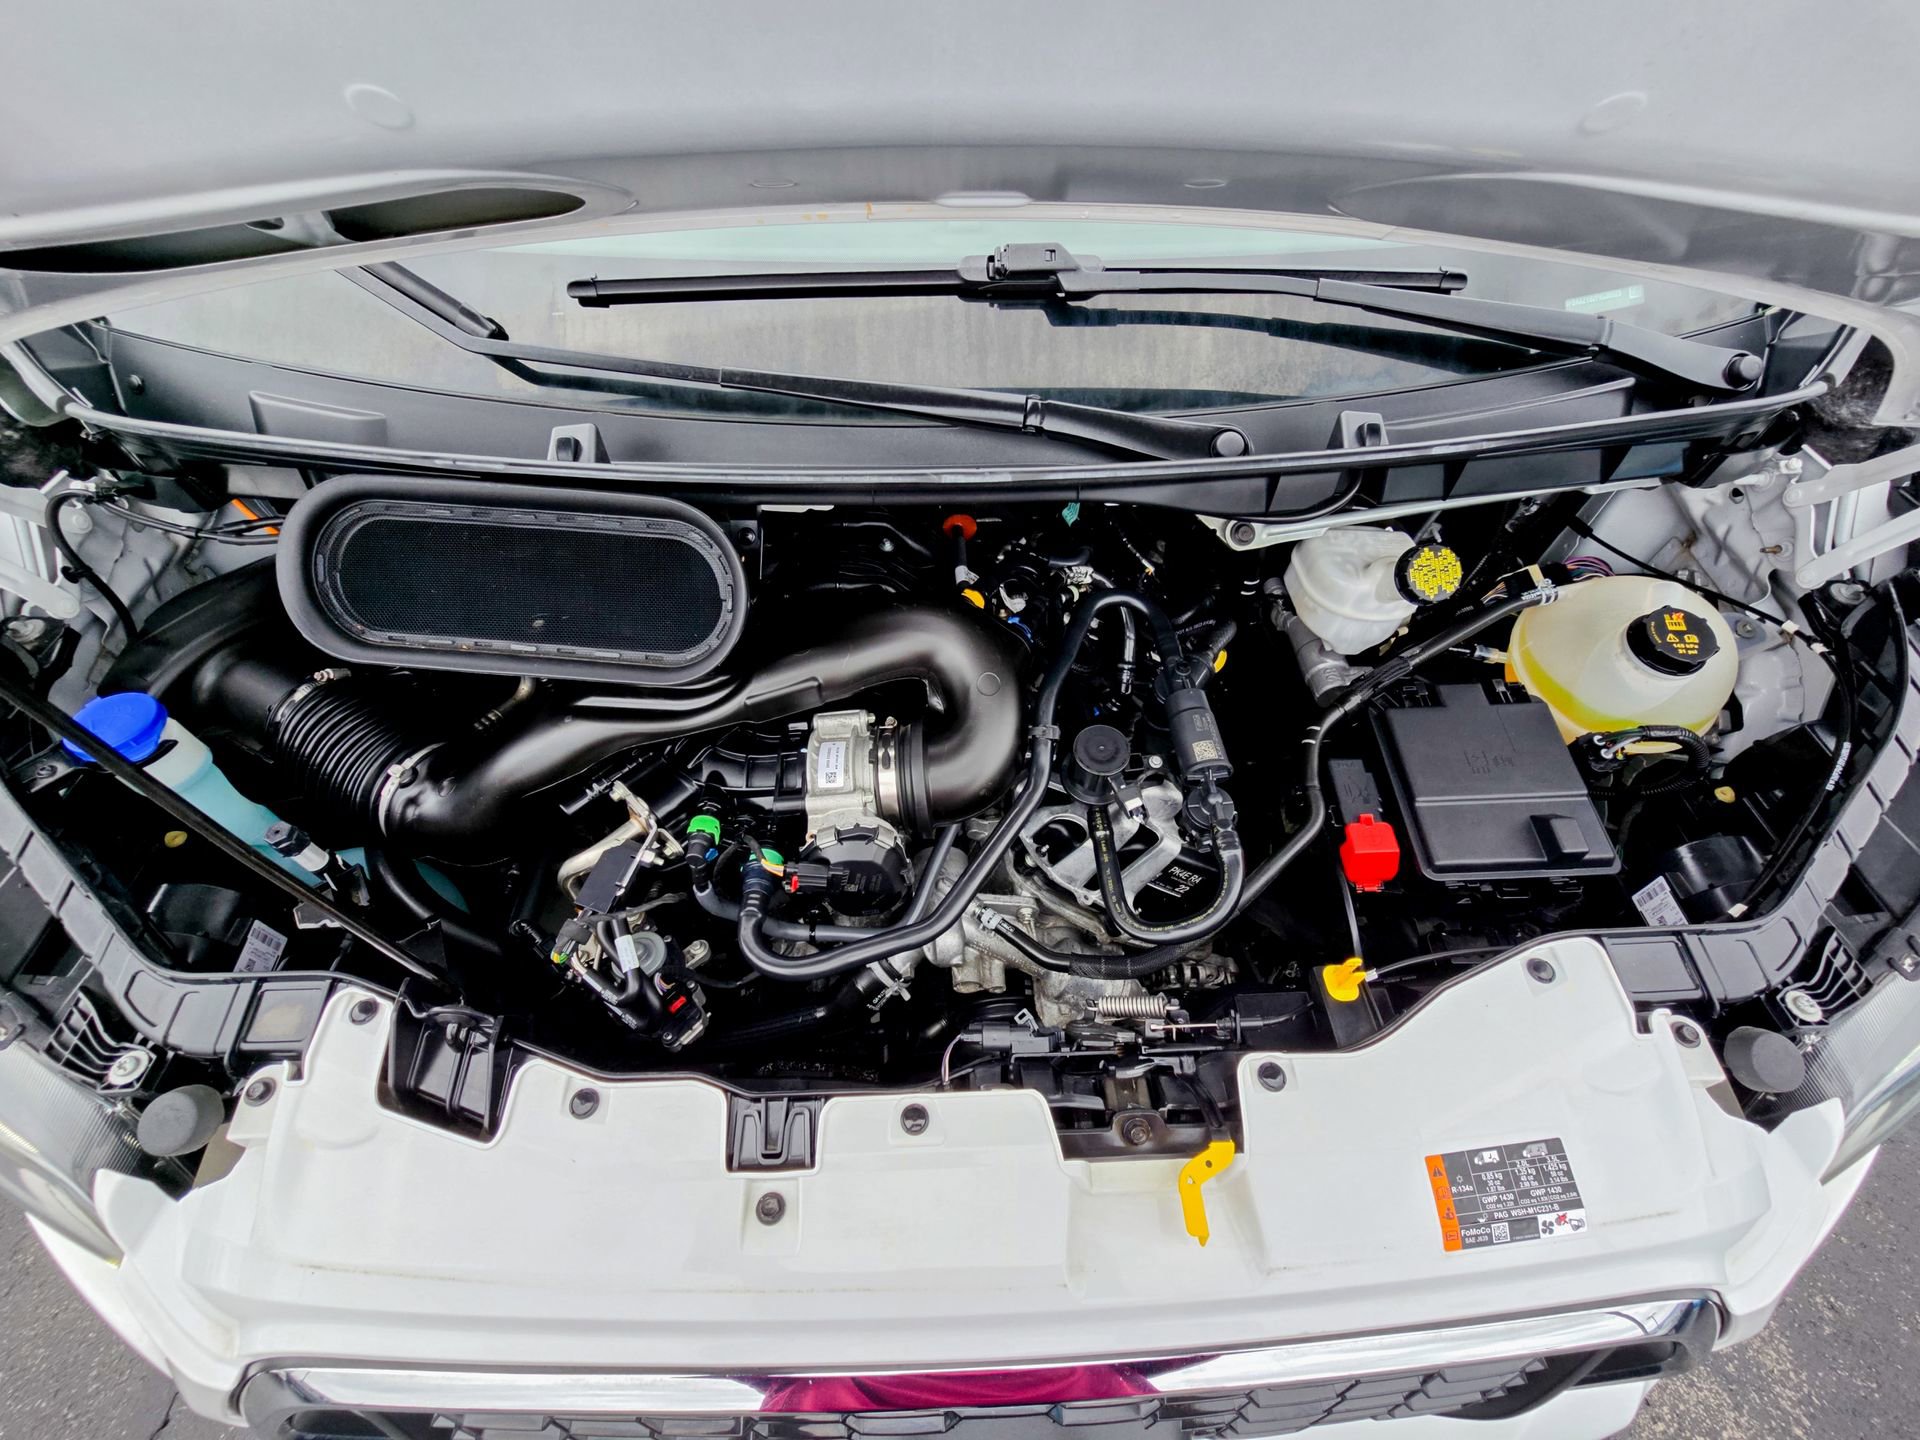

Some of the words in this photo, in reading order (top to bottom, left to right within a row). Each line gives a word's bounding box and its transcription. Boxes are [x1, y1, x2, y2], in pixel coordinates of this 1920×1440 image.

[1168, 866, 1191, 880] PK4E
[1188, 874, 1202, 884] RA
[1174, 884, 1190, 893] 22
[1543, 1163, 1559, 1171] 1.425
[1559, 1162, 1568, 1171] kg
[1495, 1172, 1503, 1180] kg
[1515, 1168, 1527, 1176] 1.35
[1527, 1167, 1536, 1175] kg
[1451, 1185, 1474, 1193] R-134a
[1530, 1188, 1546, 1197] GWP
[1547, 1186, 1562, 1194] 1430
[1482, 1196, 1498, 1204] GWP
[1499, 1193, 1514, 1201] 1430
[1494, 1210, 1509, 1219] PAG
[1510, 1205, 1560, 1217] WSH-M1C231-B
[1461, 1227, 1491, 1236] FoMoCo
